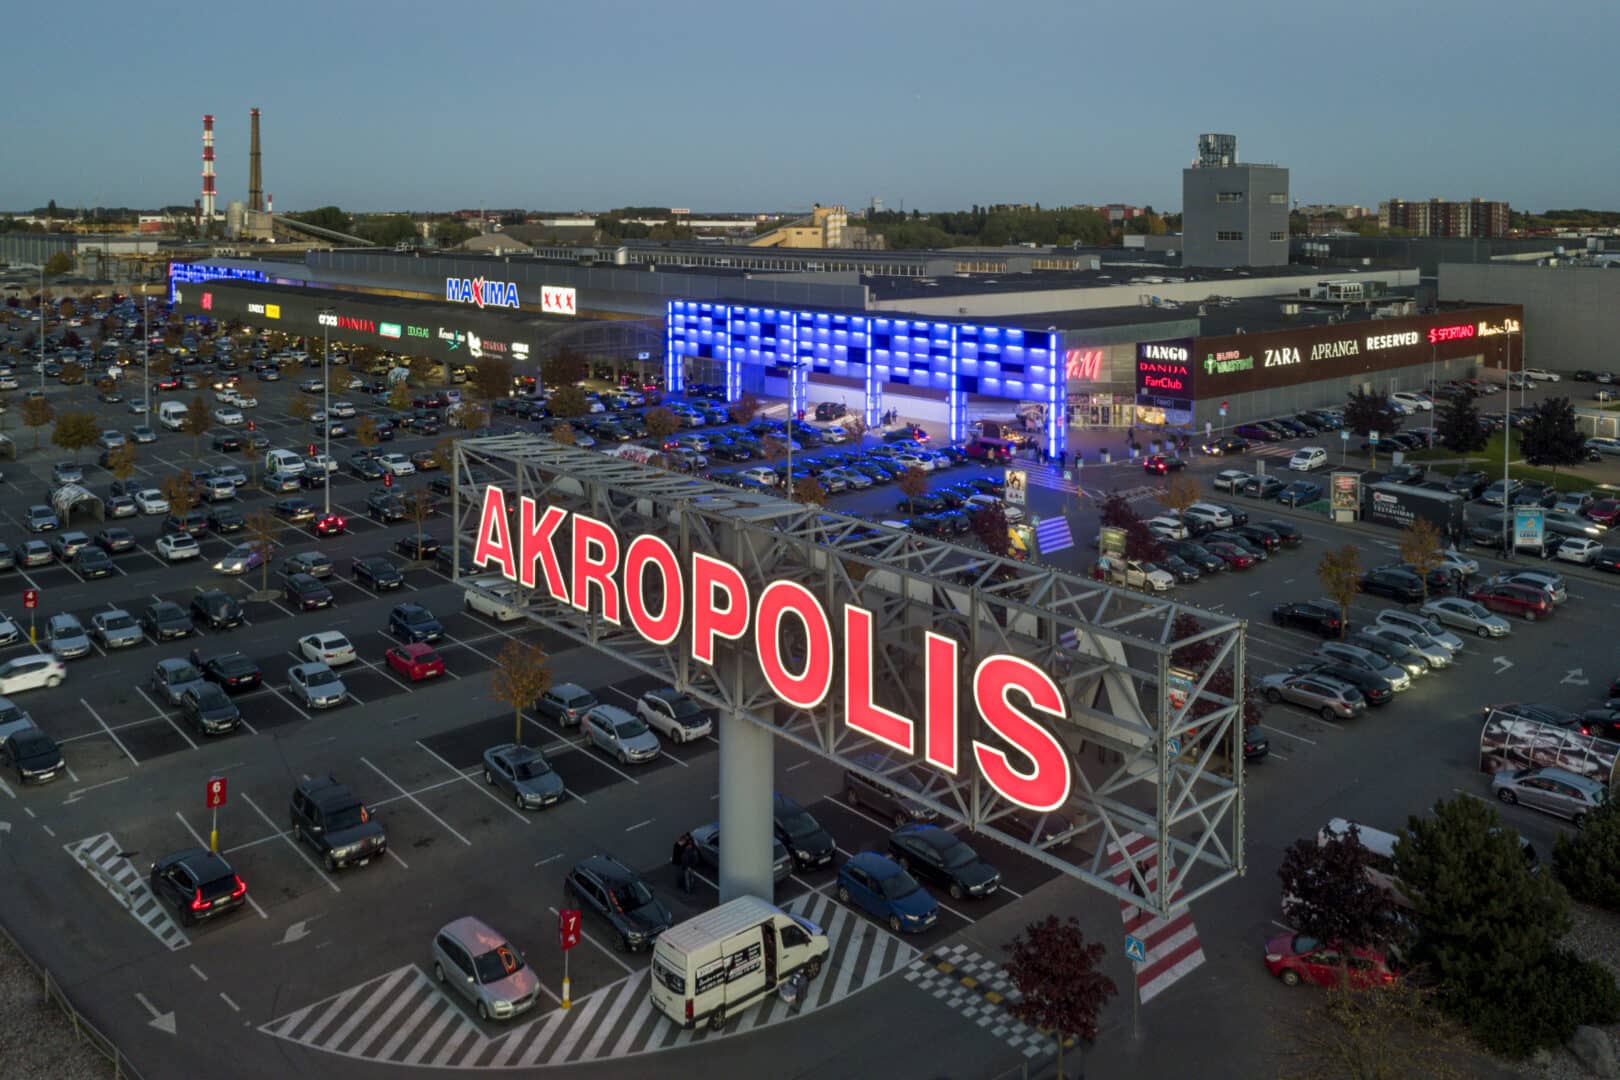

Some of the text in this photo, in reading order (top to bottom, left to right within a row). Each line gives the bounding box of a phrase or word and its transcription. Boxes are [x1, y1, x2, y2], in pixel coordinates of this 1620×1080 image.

[447, 276, 520, 308] MAXIMA
[1311, 340, 1359, 360] APRANGA
[1366, 332, 1419, 351] RESERVED
[1066, 349, 1104, 380] H&M
[1264, 347, 1301, 368] ZARA
[1139, 361, 1188, 375] DANIJA
[473, 485, 1071, 811] AKROPOLIS
[212, 781, 221, 793] 6
